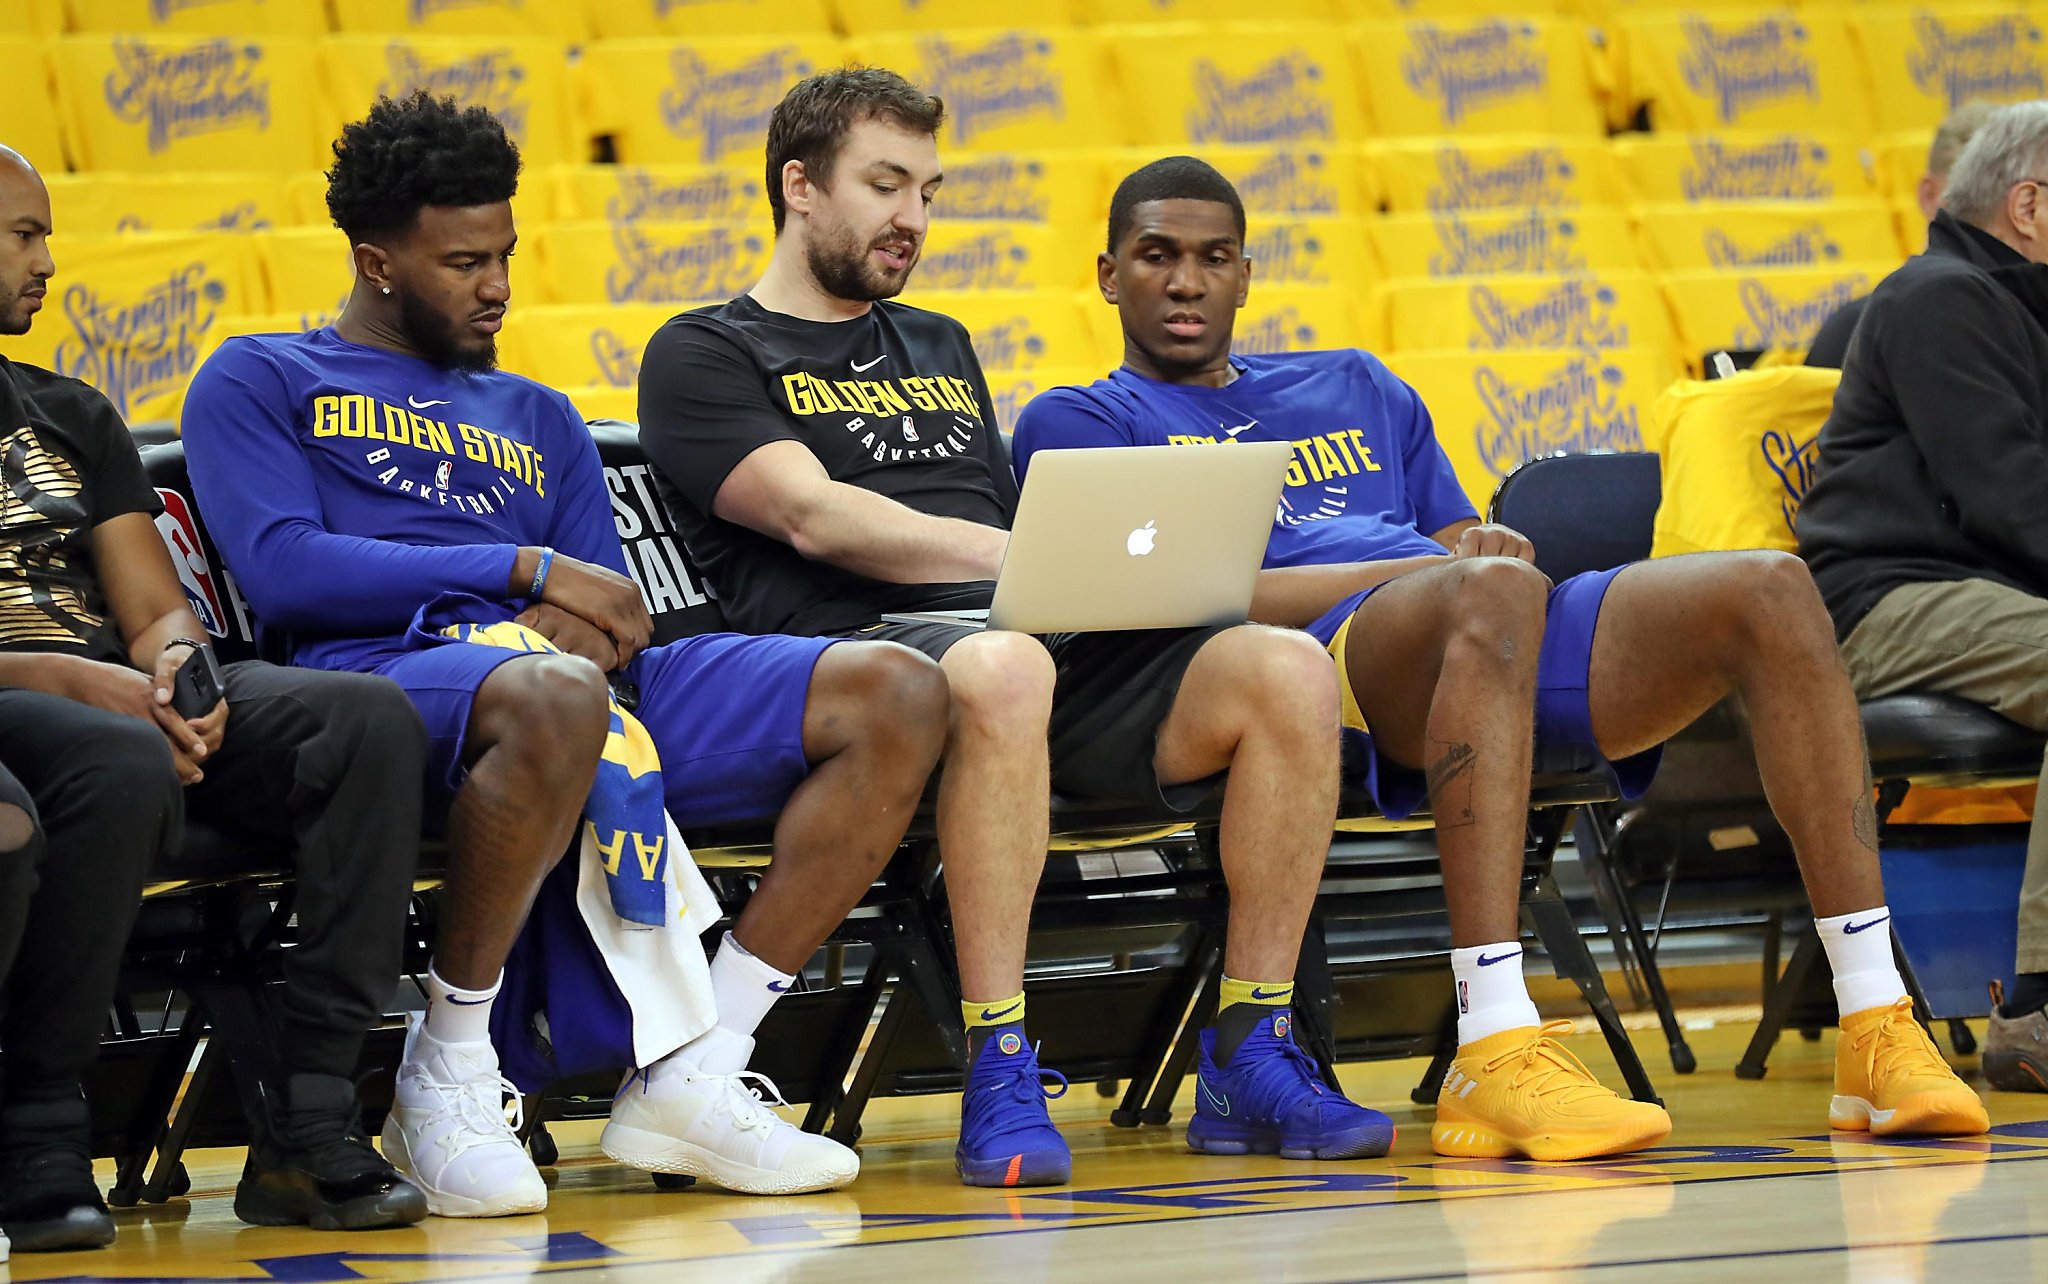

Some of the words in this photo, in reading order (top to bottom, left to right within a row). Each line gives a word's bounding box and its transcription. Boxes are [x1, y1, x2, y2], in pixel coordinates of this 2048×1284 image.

[782, 372, 912, 418] GOLDEN
[900, 376, 984, 427] STATE
[313, 394, 456, 456] GOLDEN
[457, 423, 546, 499] STATE
[1284, 429, 1382, 487] STATE
